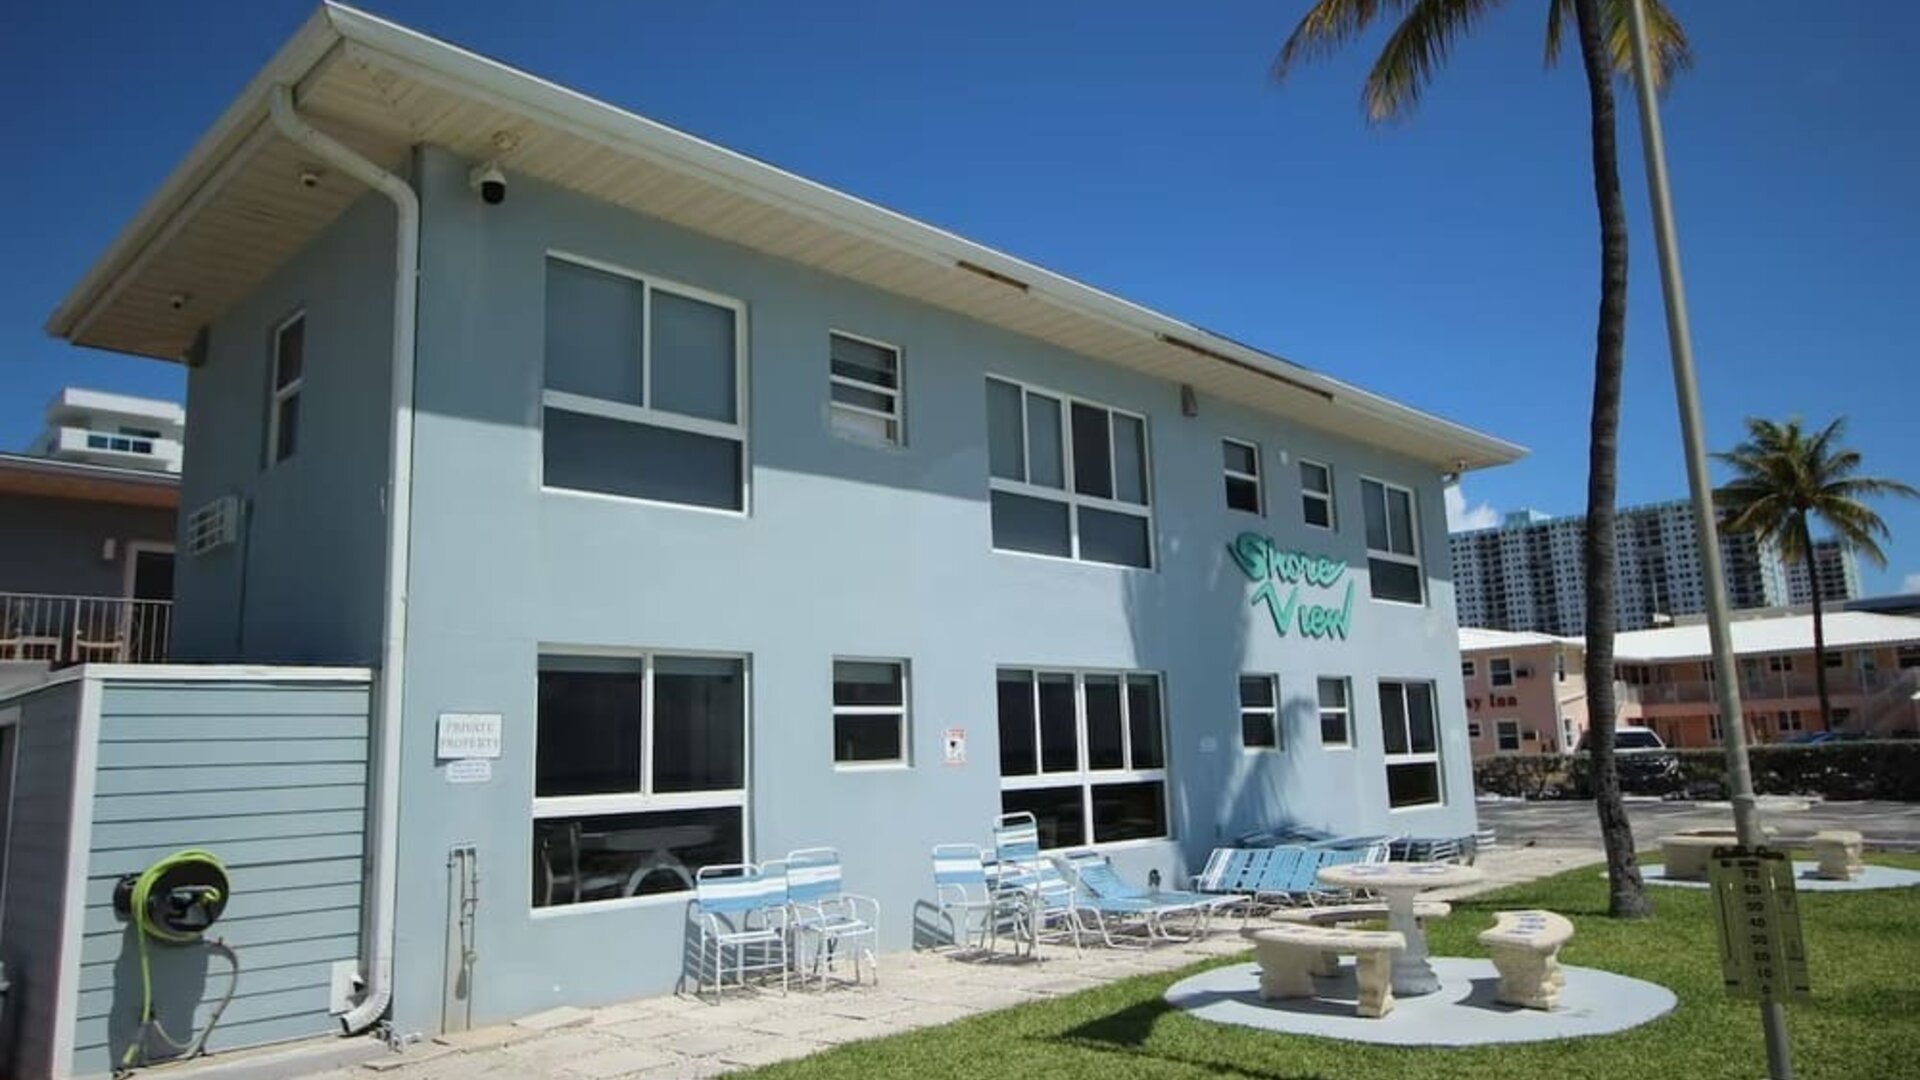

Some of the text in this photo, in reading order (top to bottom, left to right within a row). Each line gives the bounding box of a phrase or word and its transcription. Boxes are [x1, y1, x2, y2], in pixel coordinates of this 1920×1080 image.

[1227, 532, 1347, 588] Shore
[1251, 577, 1355, 640] View
[1489, 693, 1518, 708] Inn
[447, 722, 494, 732] PRIVATE
[441, 737, 498, 748] PROPERTY
[1757, 968, 1773, 978] 10
